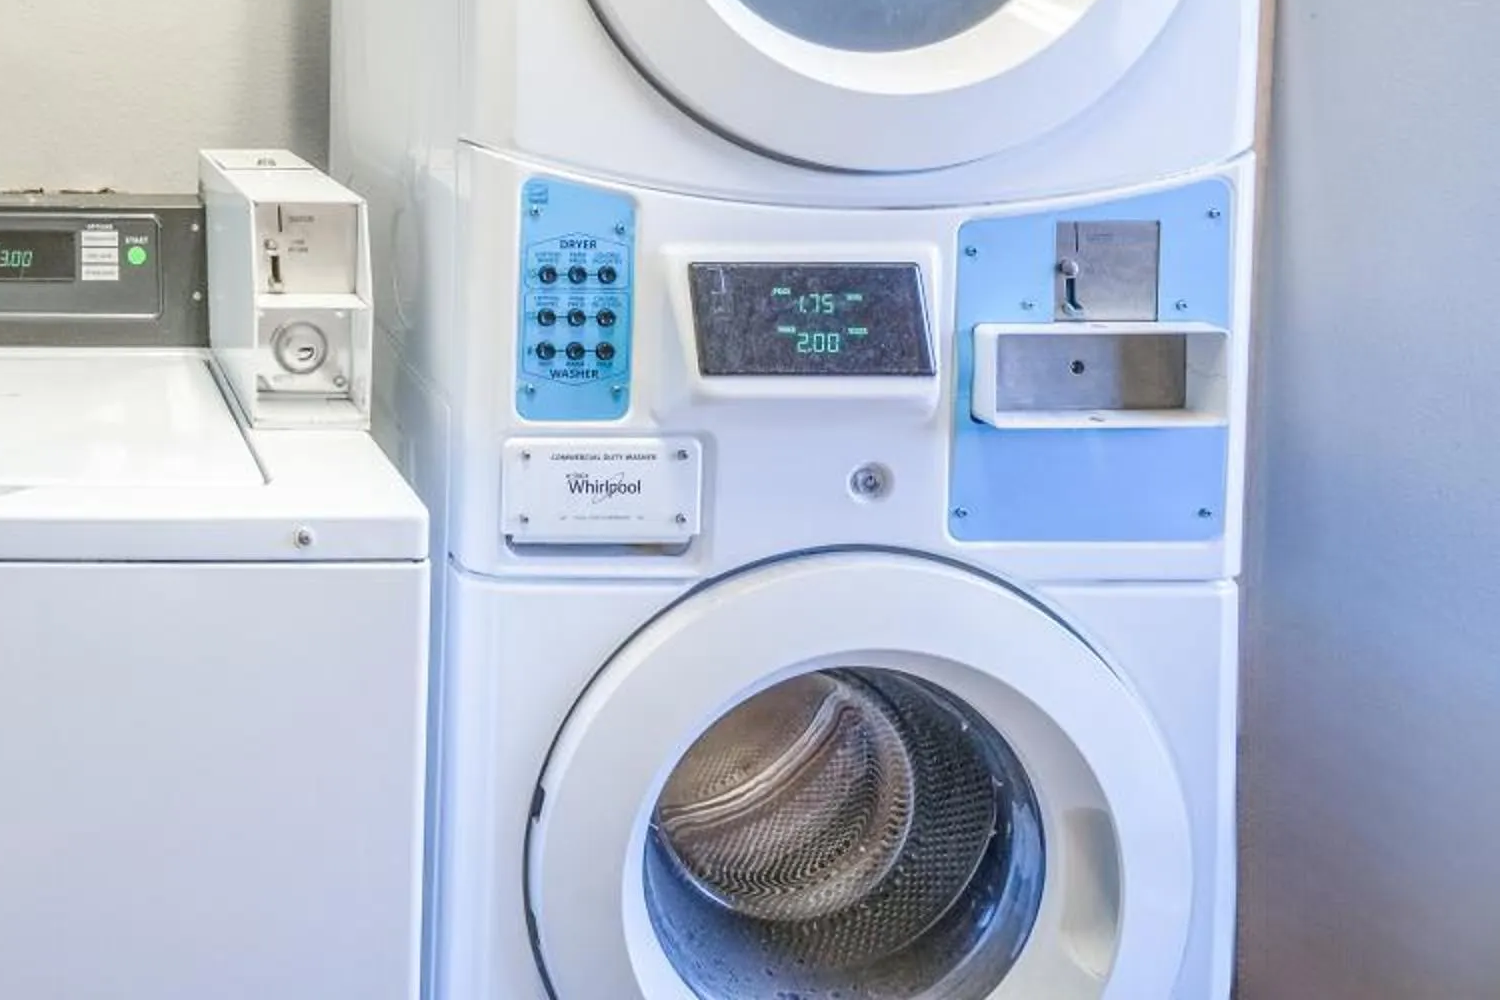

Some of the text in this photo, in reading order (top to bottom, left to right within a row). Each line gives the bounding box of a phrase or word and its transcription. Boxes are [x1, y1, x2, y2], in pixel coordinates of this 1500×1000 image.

[560, 239, 597, 249] DRYER
[796, 333, 841, 353] 2.00
[549, 368, 599, 379] WASHER
[568, 478, 642, 499] Whirlpool
